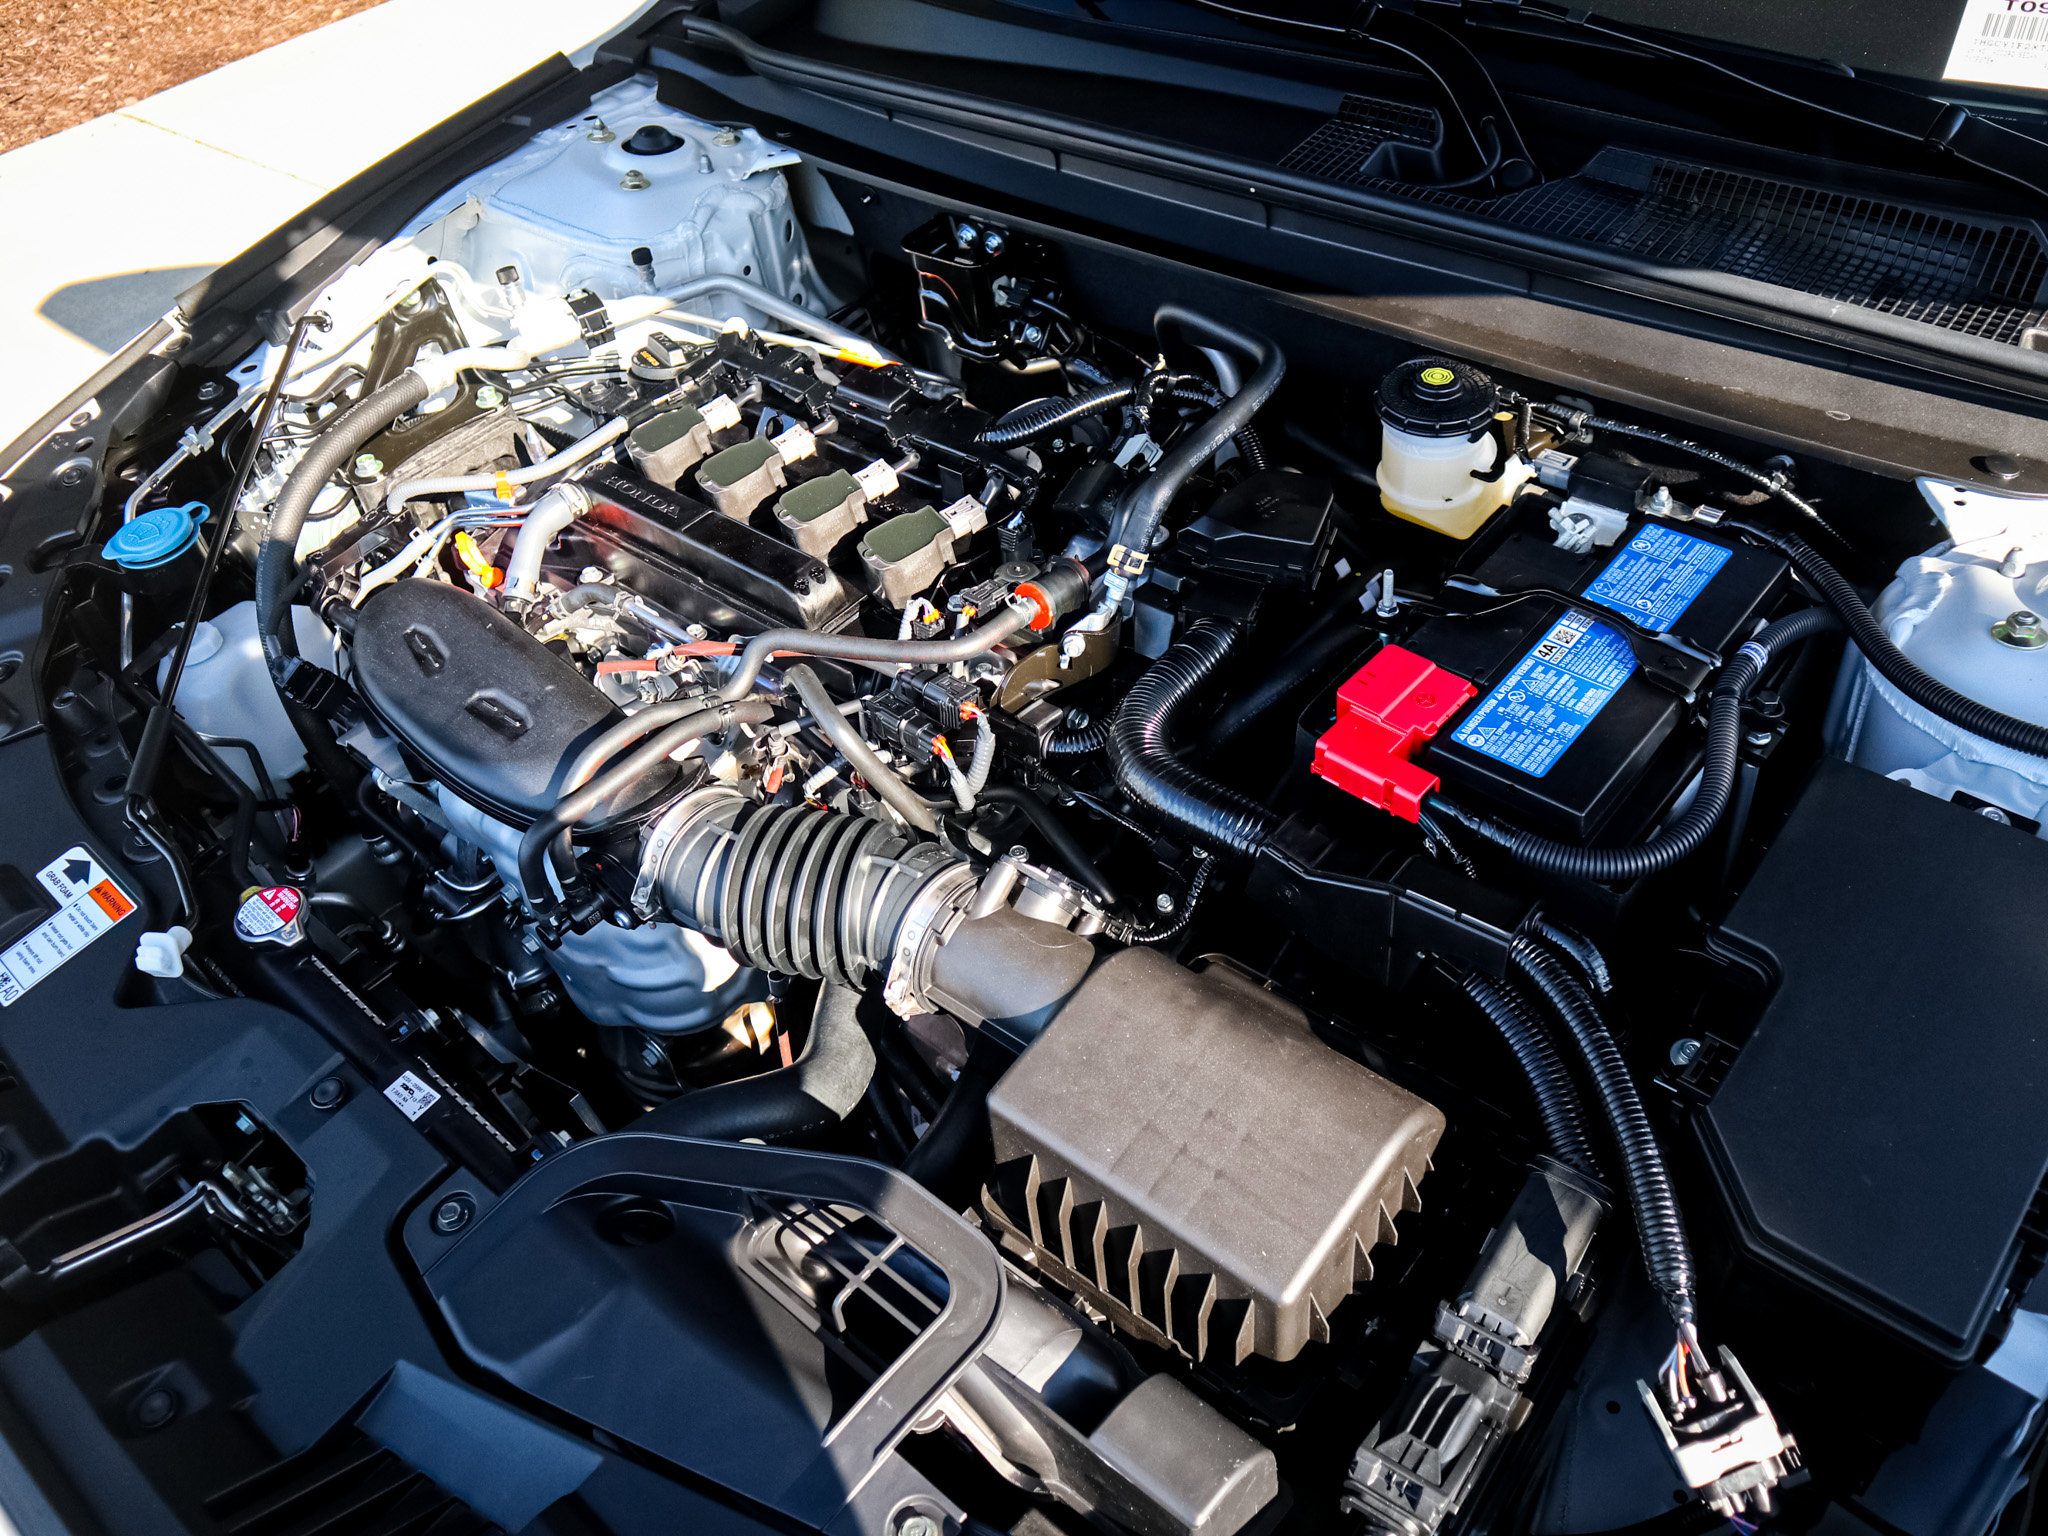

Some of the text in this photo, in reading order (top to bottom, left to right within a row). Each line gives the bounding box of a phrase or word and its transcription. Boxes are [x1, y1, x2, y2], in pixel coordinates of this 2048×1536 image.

[605, 475, 681, 519] HONDA
[1534, 641, 1558, 659] 4A
[43, 869, 74, 900] GRAB FOAM
[99, 889, 126, 916] WARNING
[0, 984, 19, 1001] A0
